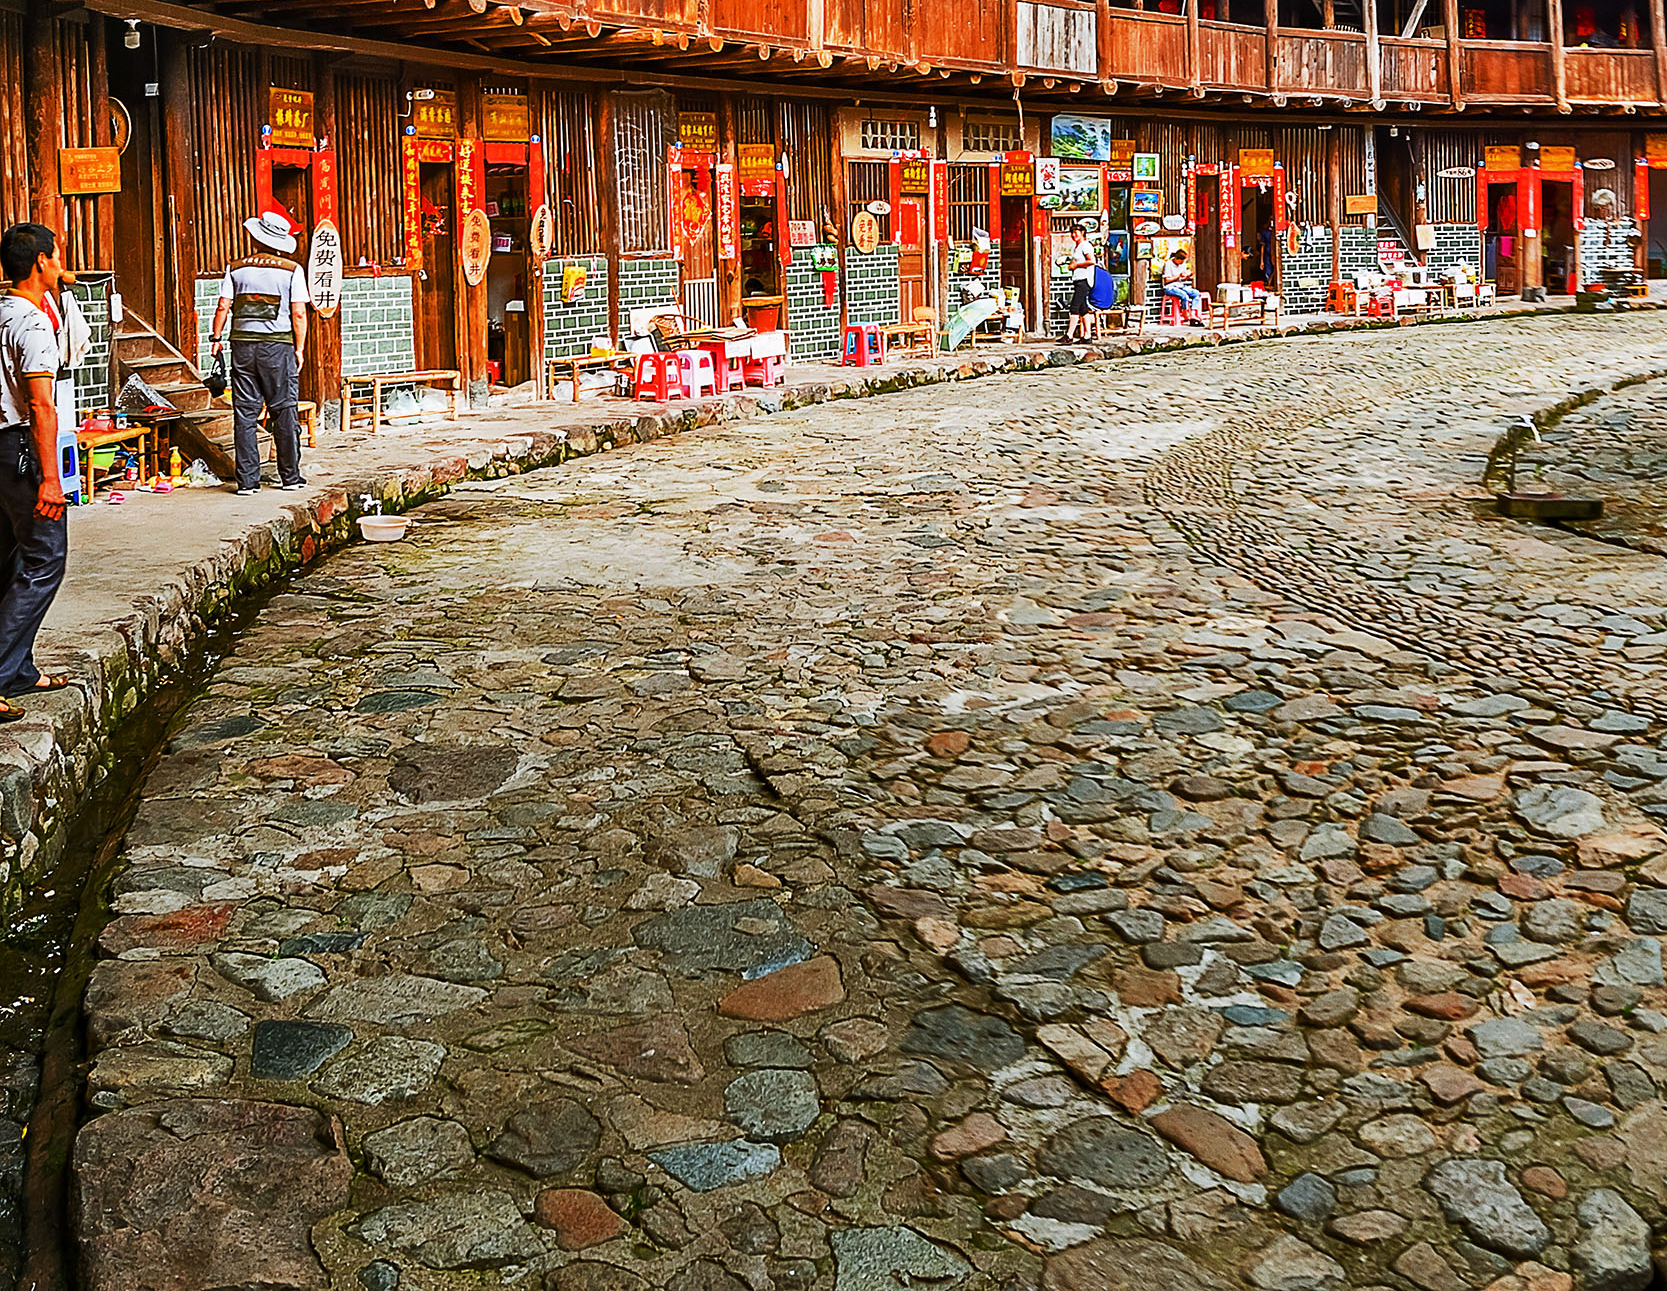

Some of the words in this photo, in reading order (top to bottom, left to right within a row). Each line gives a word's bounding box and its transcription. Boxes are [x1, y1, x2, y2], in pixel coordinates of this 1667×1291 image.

[314, 229, 337, 308] 免费看井
[469, 215, 481, 275] 免费看井
